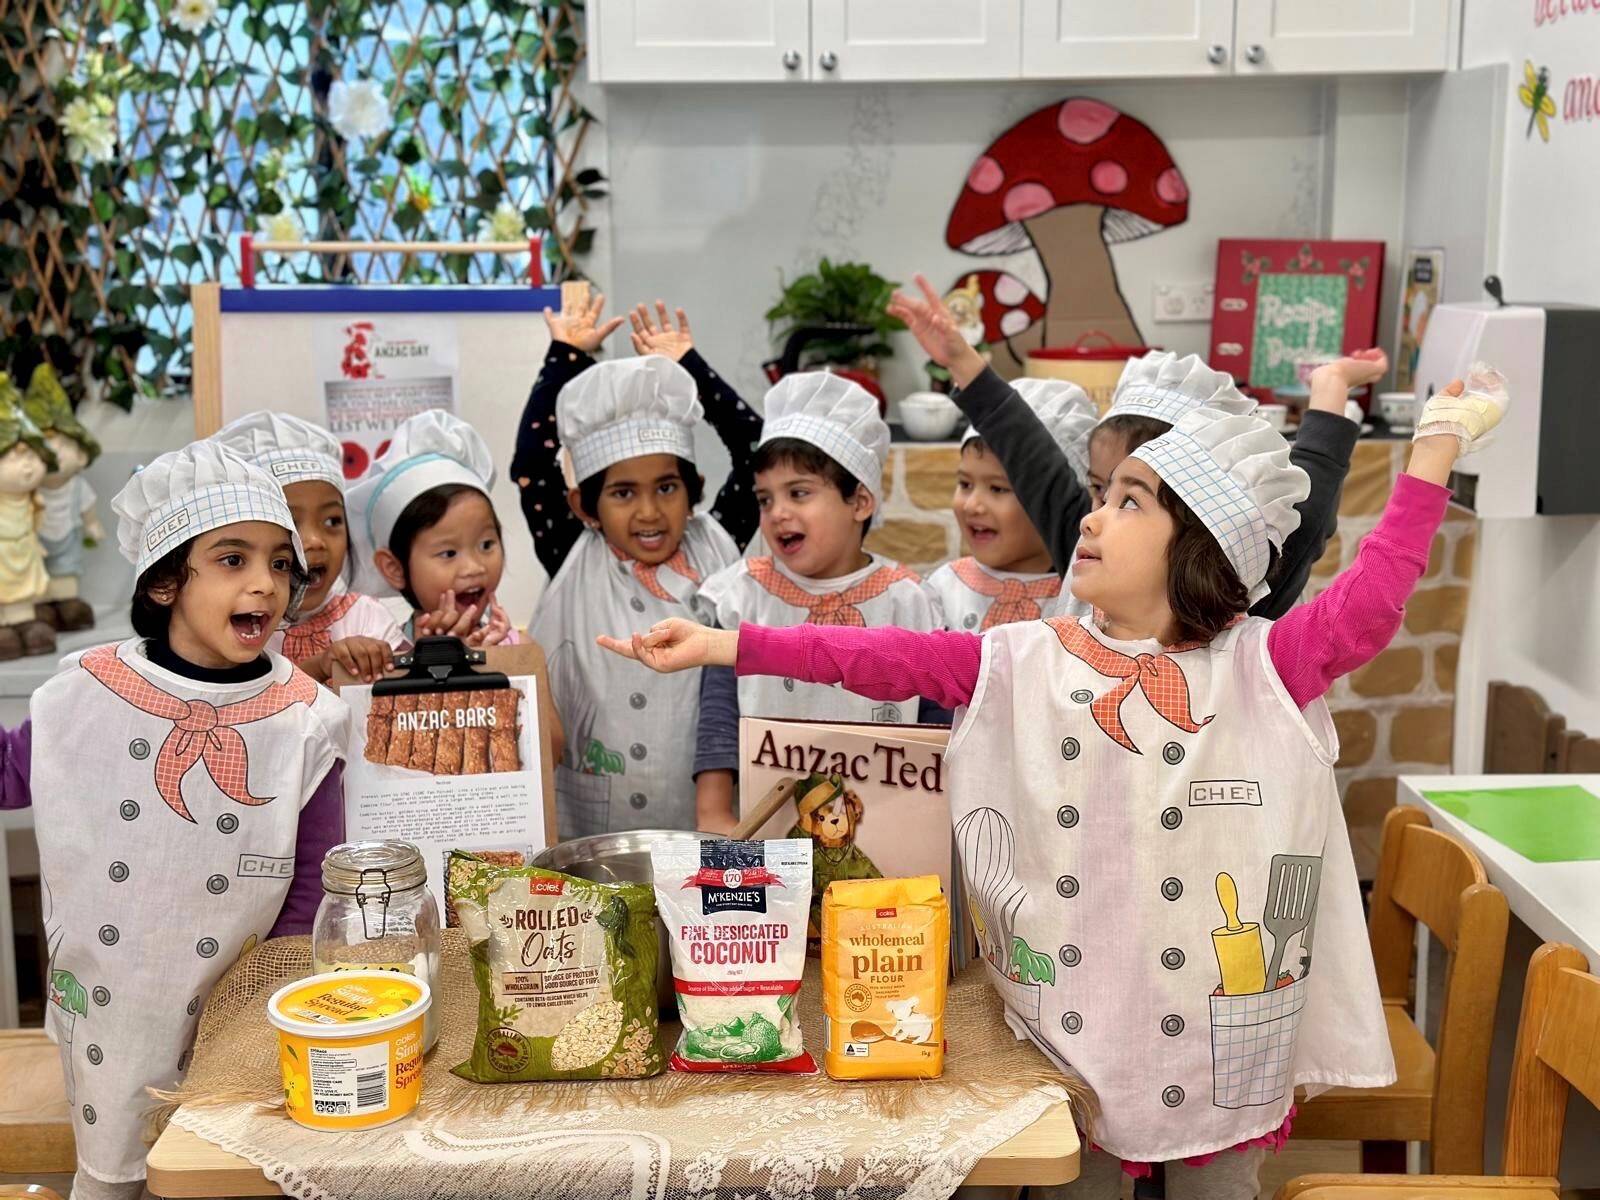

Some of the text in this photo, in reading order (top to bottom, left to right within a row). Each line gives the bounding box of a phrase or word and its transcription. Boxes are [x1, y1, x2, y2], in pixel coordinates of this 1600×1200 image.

[374, 344, 429, 358] ANZAC DAY
[330, 420, 361, 433] LEST
[367, 418, 387, 432] WE
[150, 513, 185, 545] CHEF
[397, 706, 497, 731] ANZAC BARS
[751, 730, 944, 793] Anzac Ted
[1194, 787, 1255, 800] CHEF
[243, 860, 292, 873] CHE
[536, 882, 560, 892] coles
[725, 873, 741, 883] 170
[708, 890, 760, 904] McKENZIE'S
[515, 906, 579, 931] ROLLED
[681, 923, 789, 941] FINE DESICCATED
[849, 932, 925, 947] wholemeal
[521, 929, 577, 968] Oats
[690, 940, 780, 965] COCONUT
[851, 948, 923, 980] plain
[573, 970, 594, 979] PROTEIN
[870, 974, 904, 984] FLOUR
[505, 983, 539, 991] WHOLEGRAIN
[560, 980, 578, 988] SOURCE
[305, 998, 353, 1016] Spread
[317, 993, 367, 1011] Regular
[395, 1040, 421, 1061] Simp
[395, 1053, 424, 1076] Regul
[395, 1069, 422, 1090] Spre
